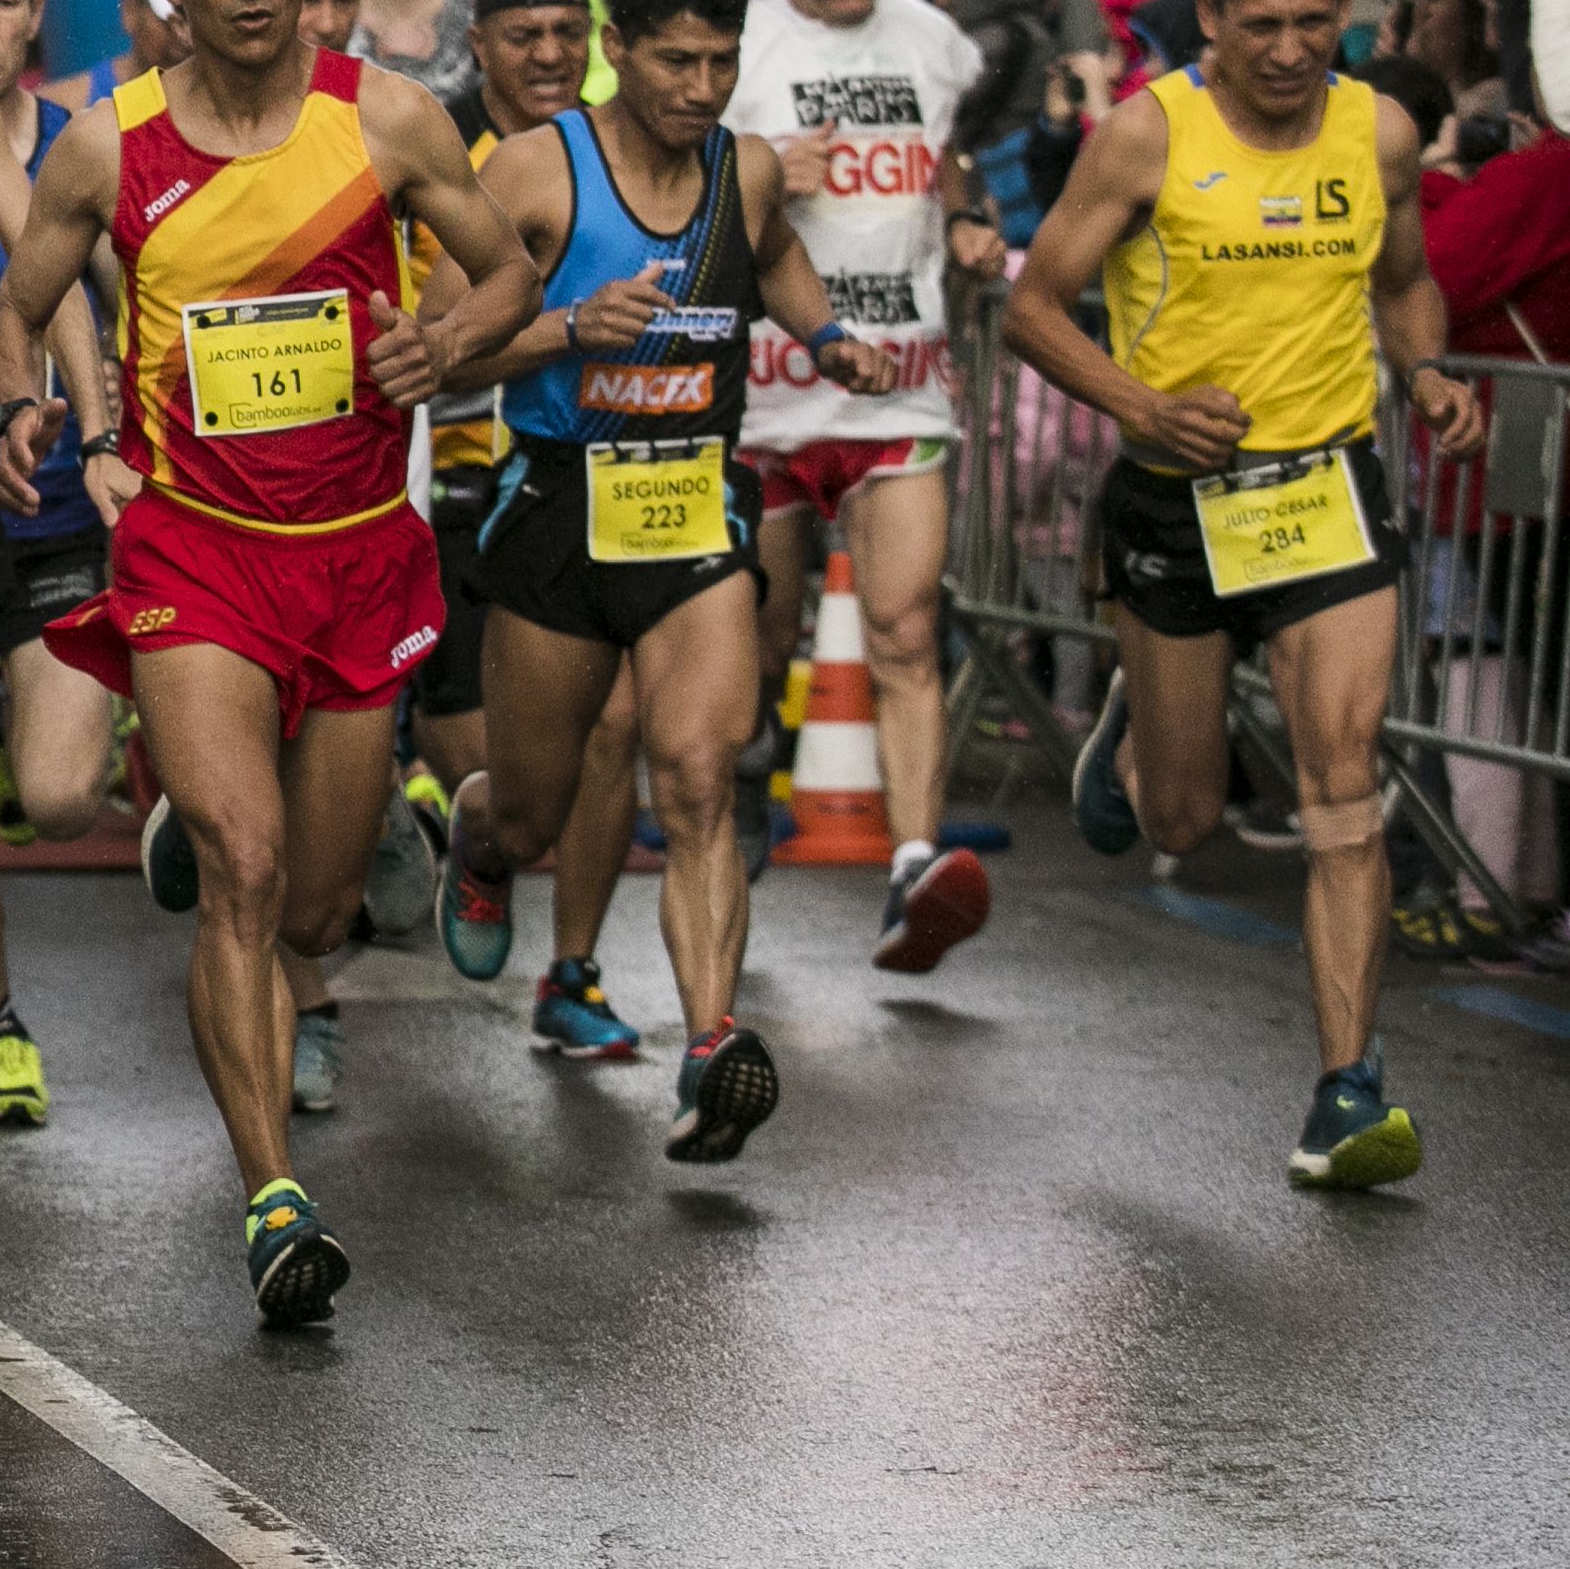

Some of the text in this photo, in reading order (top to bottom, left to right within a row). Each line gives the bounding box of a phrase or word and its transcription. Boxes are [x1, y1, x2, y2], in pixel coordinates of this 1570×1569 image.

[1315, 177, 1351, 220] LS
[1201, 238, 1357, 262] LASANSI.COM
[207, 338, 343, 364] JACINTO ARNALDO
[251, 368, 303, 398] 161
[611, 478, 711, 501] SEGUNDO
[640, 503, 687, 531] 223
[1222, 506, 1271, 530] JULIO
[1259, 522, 1307, 554] 284
[128, 606, 177, 636] ESP
